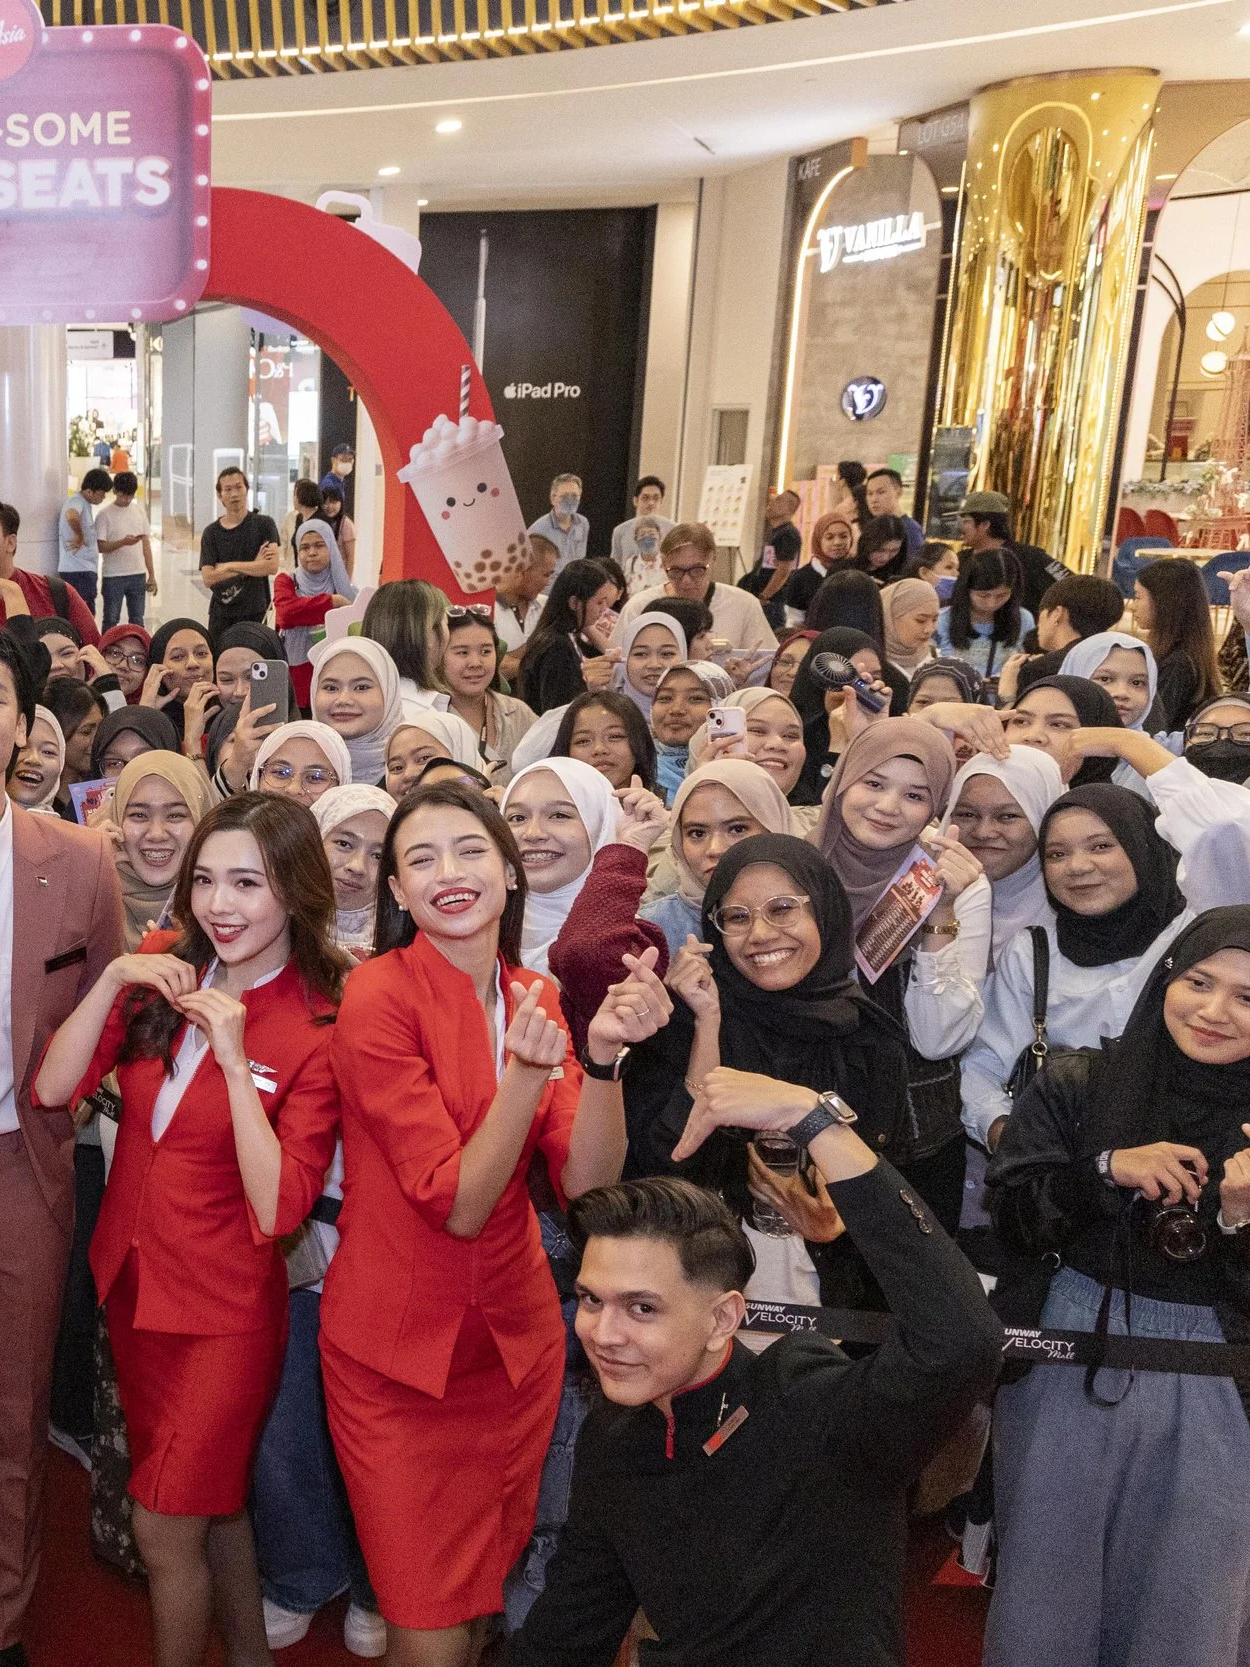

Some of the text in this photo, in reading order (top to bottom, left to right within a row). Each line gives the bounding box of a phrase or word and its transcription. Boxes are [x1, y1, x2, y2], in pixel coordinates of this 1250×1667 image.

[844, 212, 924, 253] VANILLA
[517, 382, 581, 398] iPad Pro
[745, 1302, 785, 1313] SUNWAY
[744, 1310, 817, 1327] VELOCITY
[1004, 1328, 1042, 1338] UNWAY
